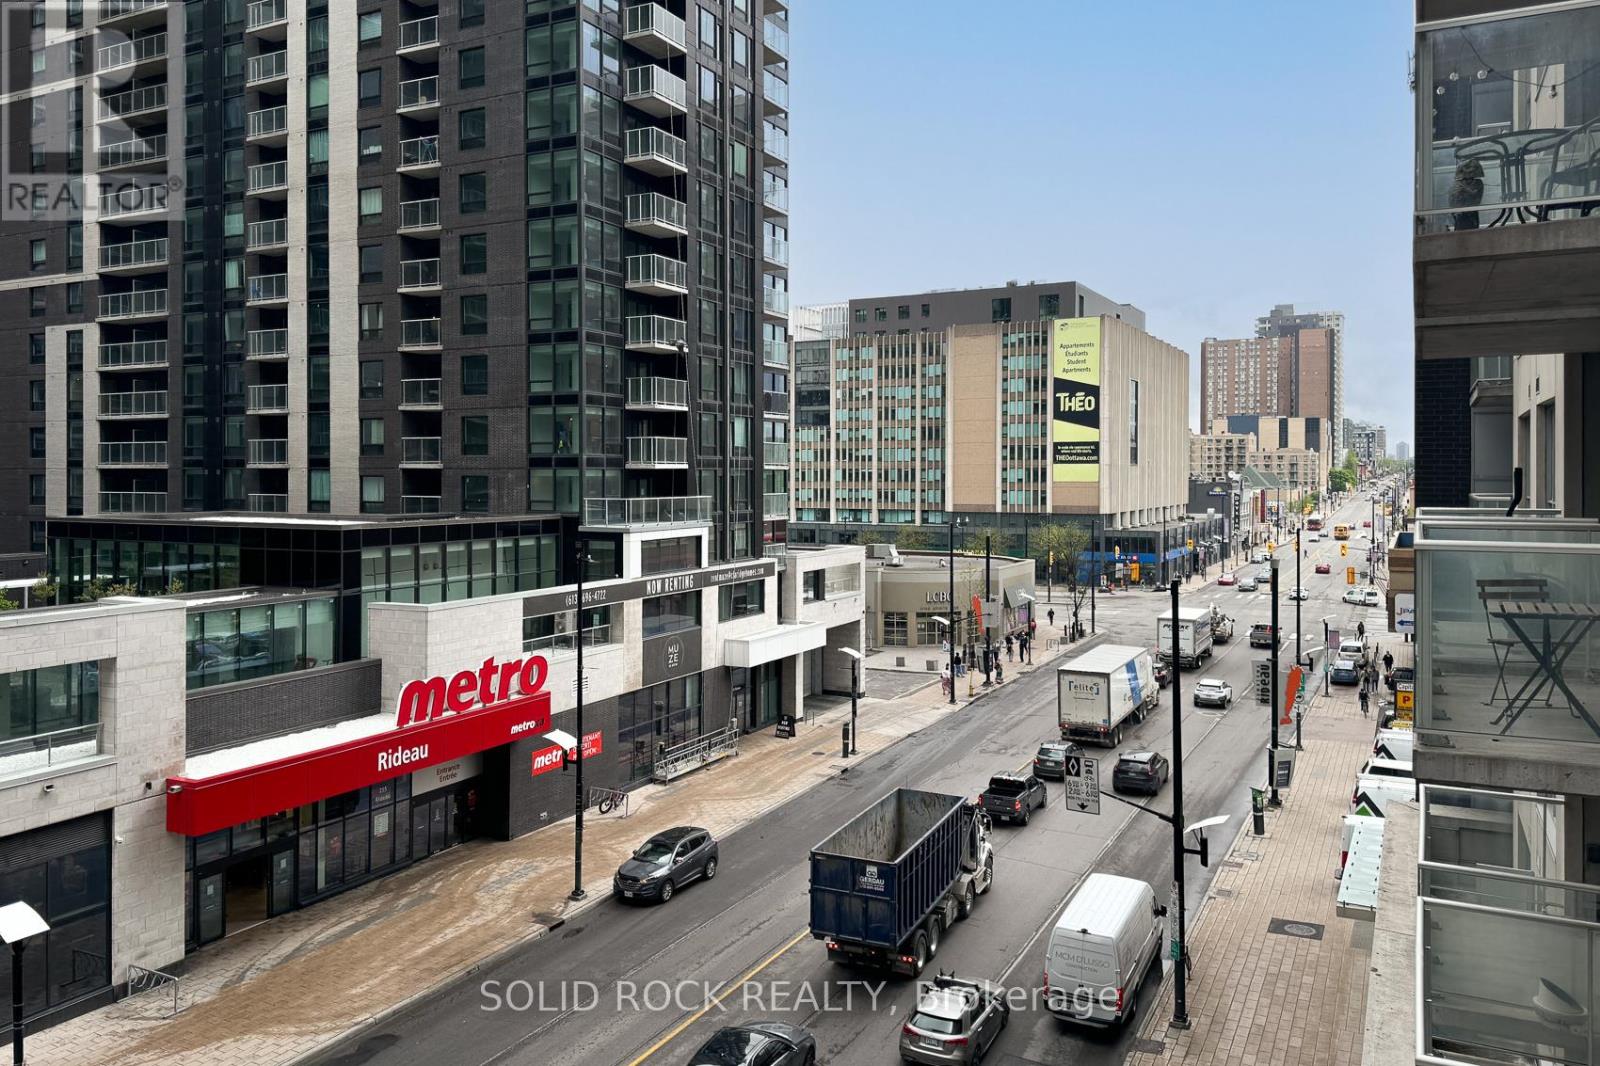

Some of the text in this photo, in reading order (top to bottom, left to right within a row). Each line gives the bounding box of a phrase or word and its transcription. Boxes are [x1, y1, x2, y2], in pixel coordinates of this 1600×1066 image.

[646, 575, 693, 595] NOW RENTING
[566, 594, 577, 606] (613
[396, 655, 549, 727] metro
[1402, 695, 1411, 704] P
[377, 743, 429, 772] Rideau
[533, 749, 563, 770] metr
[436, 763, 461, 776] Entrance
[859, 875, 885, 885] GERDAU
